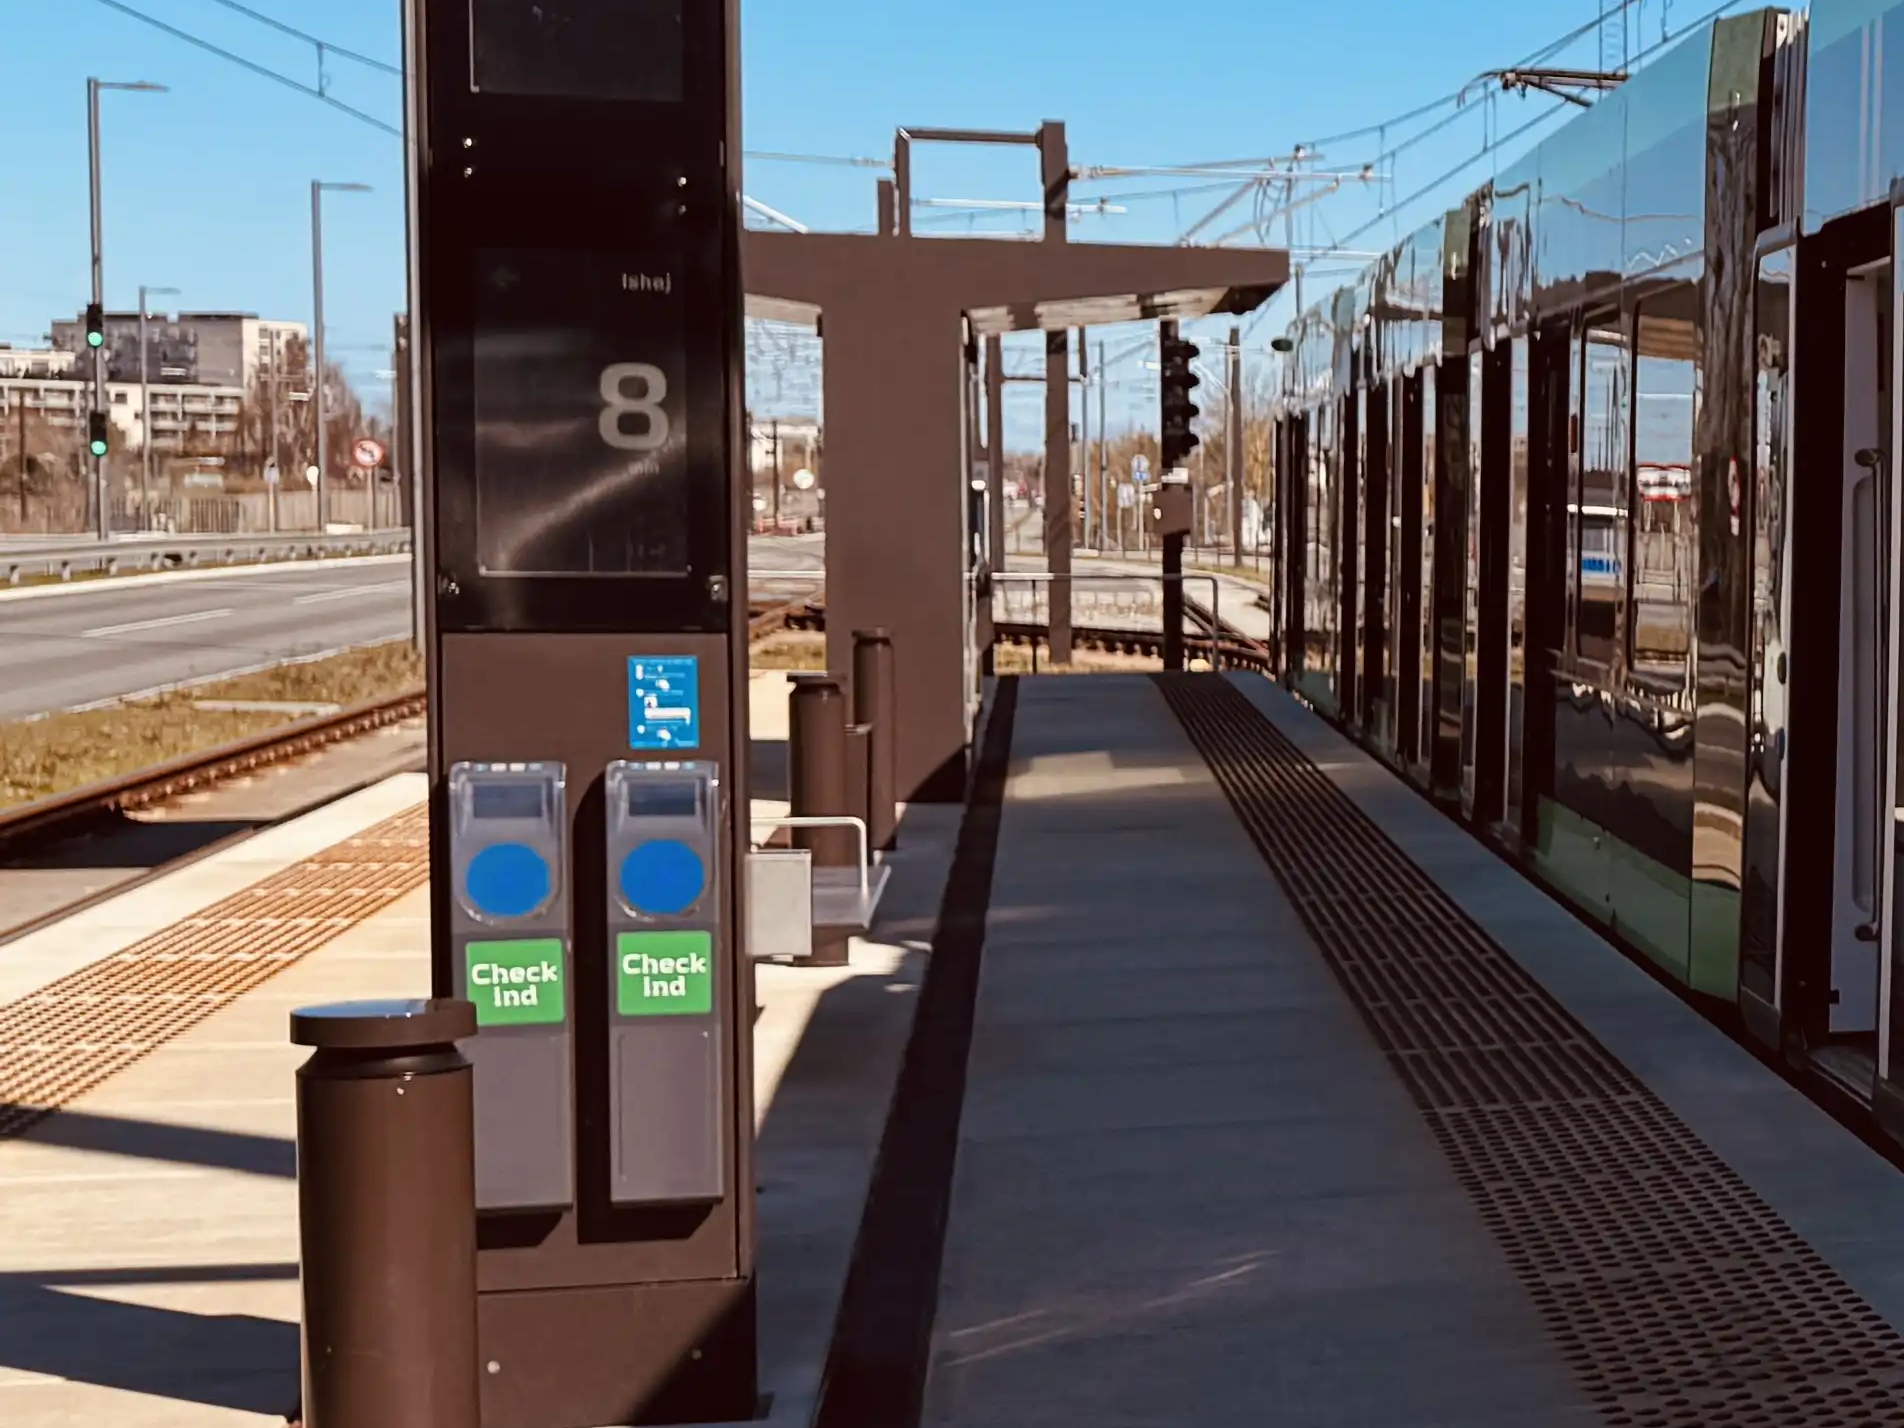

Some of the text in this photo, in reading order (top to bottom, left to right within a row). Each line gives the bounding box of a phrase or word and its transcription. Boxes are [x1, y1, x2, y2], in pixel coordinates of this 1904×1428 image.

[599, 362, 669, 450] 8
[471, 961, 558, 985] Check
[622, 952, 707, 974] Check
[494, 984, 538, 1007] Ind
[643, 975, 686, 997] Ind
